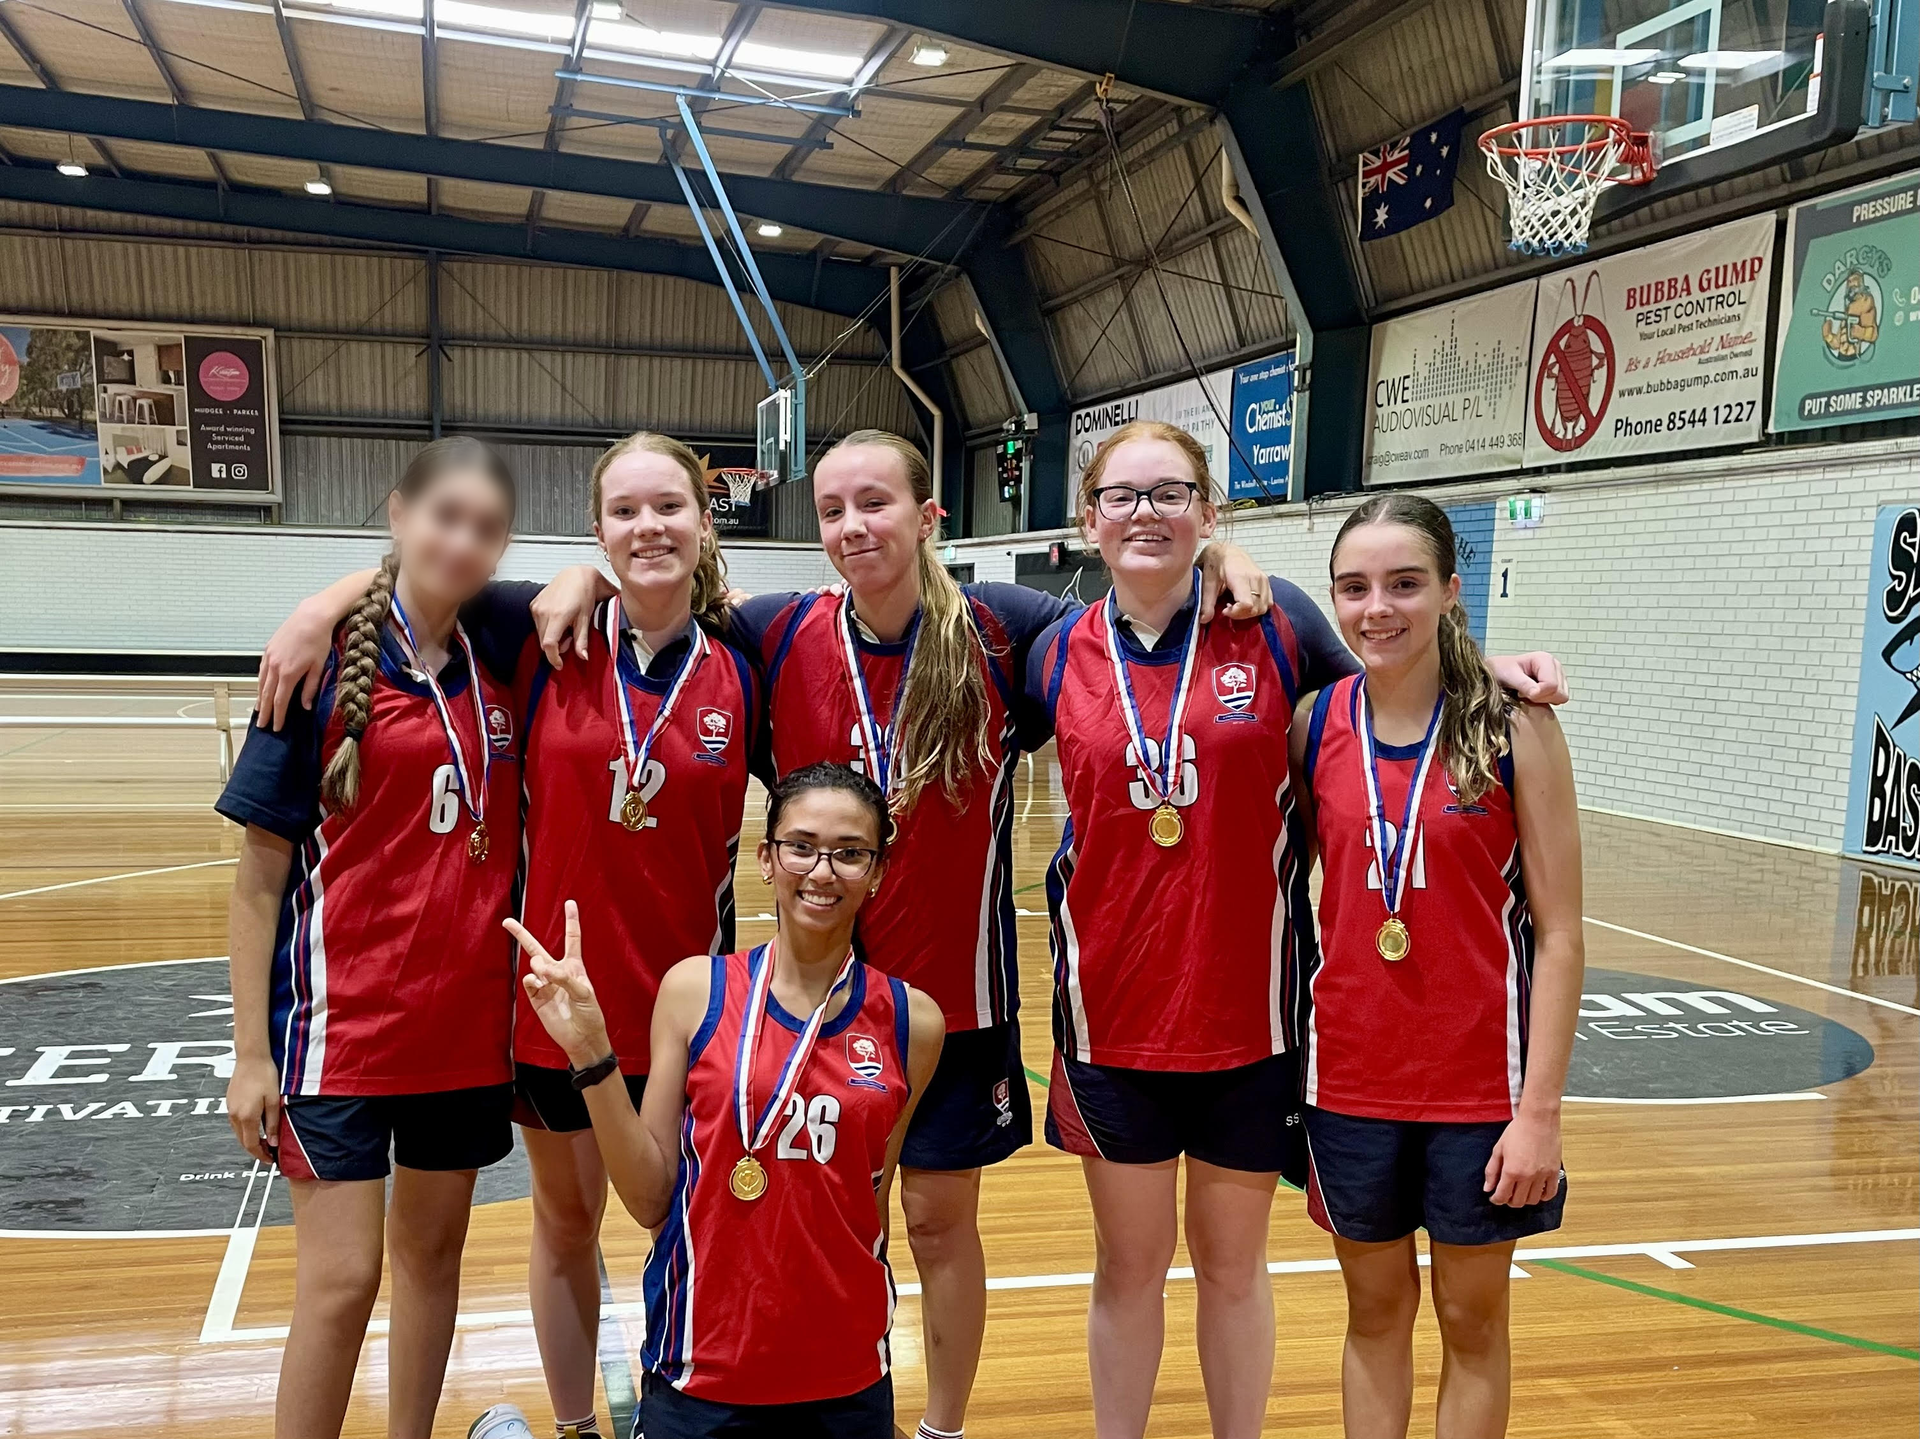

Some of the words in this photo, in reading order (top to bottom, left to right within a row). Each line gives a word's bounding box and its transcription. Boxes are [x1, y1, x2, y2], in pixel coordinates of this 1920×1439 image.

[1853, 190, 1914, 223] PRESSURE
[1625, 274, 1692, 311] BUBBA
[1698, 256, 1763, 293] GUMP
[1636, 306, 1671, 328] PEST
[1674, 290, 1746, 319] CONTROL
[1639, 331, 1655, 341] Your
[1656, 324, 1676, 338] Local
[1678, 323, 1693, 334] Pest
[1696, 313, 1741, 329] Technicians
[1642, 357, 1651, 369] a
[1374, 374, 1411, 408] CWE
[1618, 366, 1759, 398] www.bubbagump.com.au
[1374, 400, 1458, 433] AUDIOVISUAL
[1462, 395, 1483, 420] P/L
[1804, 397, 1828, 416] PUT
[1829, 392, 1863, 412] SOME
[1865, 384, 1920, 408] SPARKLE
[200, 424, 224, 432] Award
[226, 426, 255, 435] winning
[1075, 399, 1139, 435] DOMINELLI
[1614, 417, 1662, 438] Phone
[1666, 407, 1707, 431] 8544
[1713, 400, 1756, 425] 1227
[207, 442, 251, 451] Apartments
[211, 433, 245, 441] Serviced
[1440, 443, 1464, 456] Phone
[1465, 438, 1486, 452] 0414
[1488, 435, 1505, 449] 449
[1507, 432, 1523, 448] 368
[709, 497, 737, 512] AST
[713, 517, 739, 525] om.au
[1500, 567, 1509, 598] 1
[1124, 734, 1199, 811] 36
[1862, 711, 1920, 861] BAS
[429, 763, 462, 835] 6
[607, 756, 668, 829] 12
[1364, 819, 1428, 890] 21
[1579, 991, 1780, 1018] am
[1588, 1020, 1810, 1040] Estate
[776, 1092, 842, 1165] 26
[179, 1171, 236, 1181] Drink
